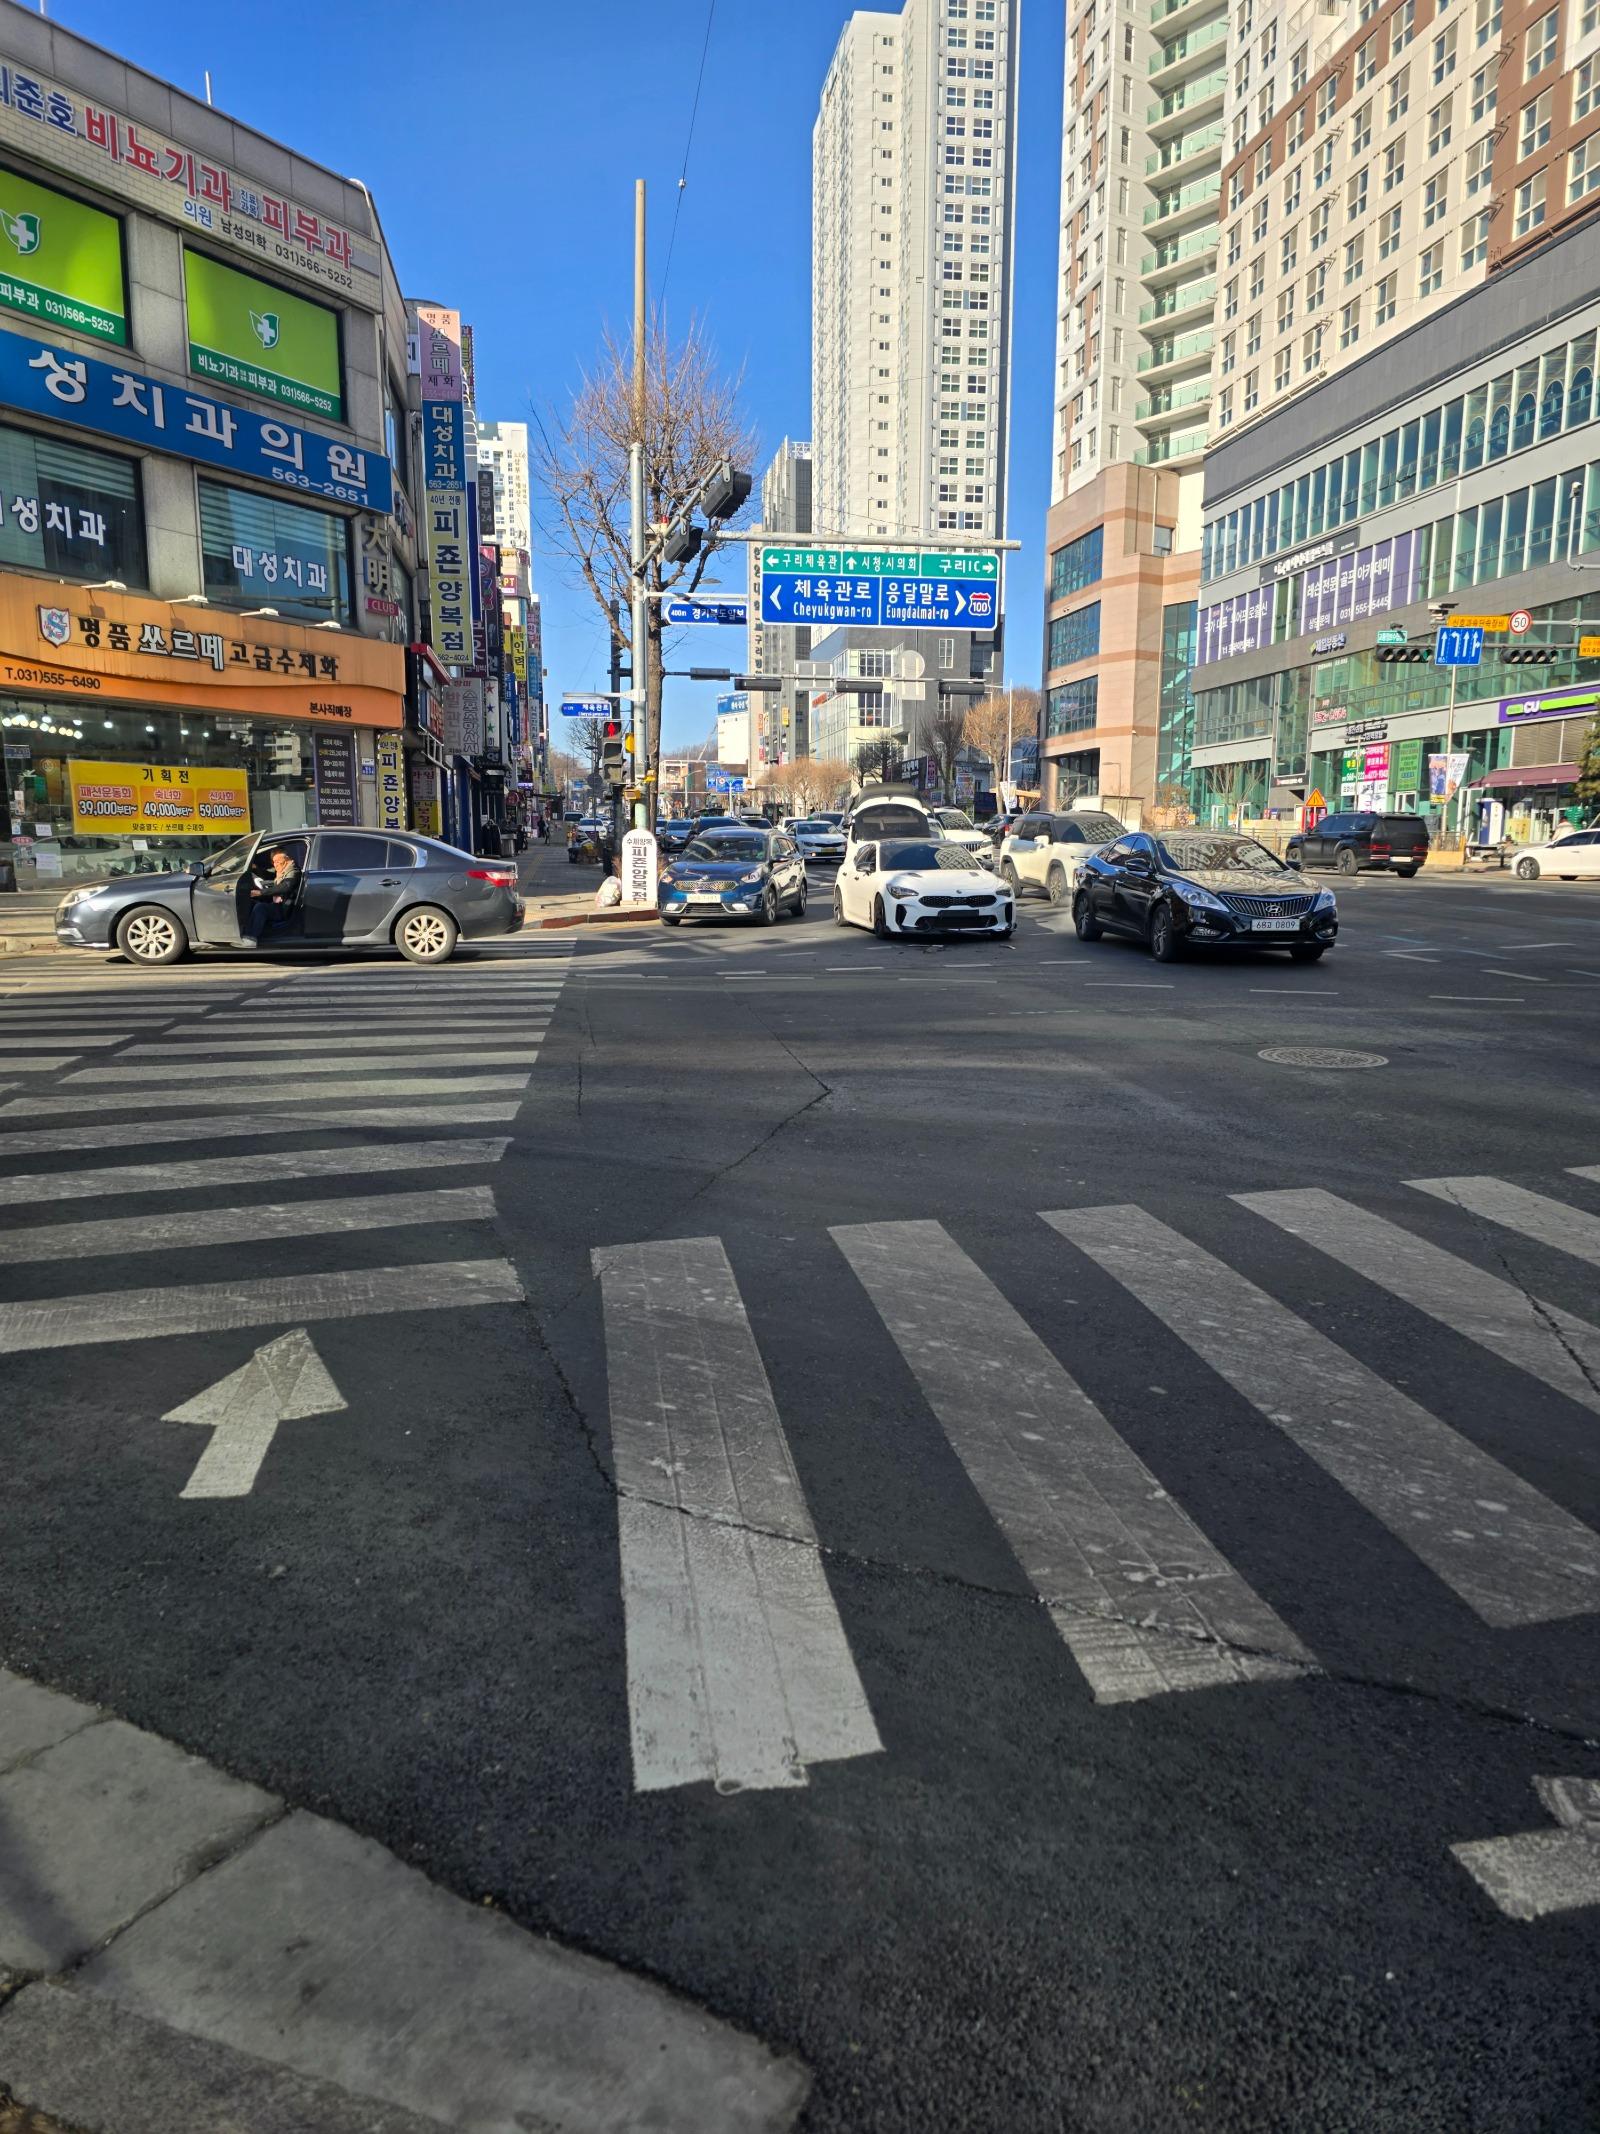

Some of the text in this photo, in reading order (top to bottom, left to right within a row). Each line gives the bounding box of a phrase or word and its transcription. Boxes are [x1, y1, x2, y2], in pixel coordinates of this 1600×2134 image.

[84, 104, 234, 215] 비뇨기과
[261, 193, 353, 271] 피부과
[184, 199, 353, 289] 의원 남성의학 031)566-5252
[0, 283, 115, 334] 피부과 031)566-5252
[426, 313, 450, 325] 명품
[198, 354, 238, 381] 비뇨기과
[248, 372, 277, 394] 피부과
[281, 385, 332, 411] 031)566-5252
[428, 375, 454, 387] 제화
[431, 405, 458, 480] 대성치과
[272, 466, 368, 506] 563-2651
[428, 480, 463, 491] 563-2651
[0, 490, 106, 546] 성치과
[362, 520, 391, 594] 大明
[782, 554, 838, 570] 구리체육관
[938, 559, 980, 574] 구리IC
[232, 545, 328, 592] 대성치과
[432, 509, 464, 651] 피죤양복점
[794, 579, 872, 602] 체육관로
[885, 582, 949, 605] 응달말로
[371, 600, 395, 614] CLUB
[793, 602, 872, 619] Cheyukgwan-ro
[886, 604, 949, 621] Eungdalmal-ro
[972, 602, 988, 613] 100
[1513, 617, 1526, 628] 50
[78, 617, 131, 651] 명품
[229, 641, 339, 681] 고급수제화
[5, 666, 101, 690] T.031)555-6490
[309, 701, 352, 718] 본사직매장
[1523, 700, 1540, 714] CU
[142, 768, 190, 784] 기획전
[154, 790, 182, 801] 숙녀화
[209, 790, 235, 801] 신사화
[632, 846, 648, 902] 피죤양복점
